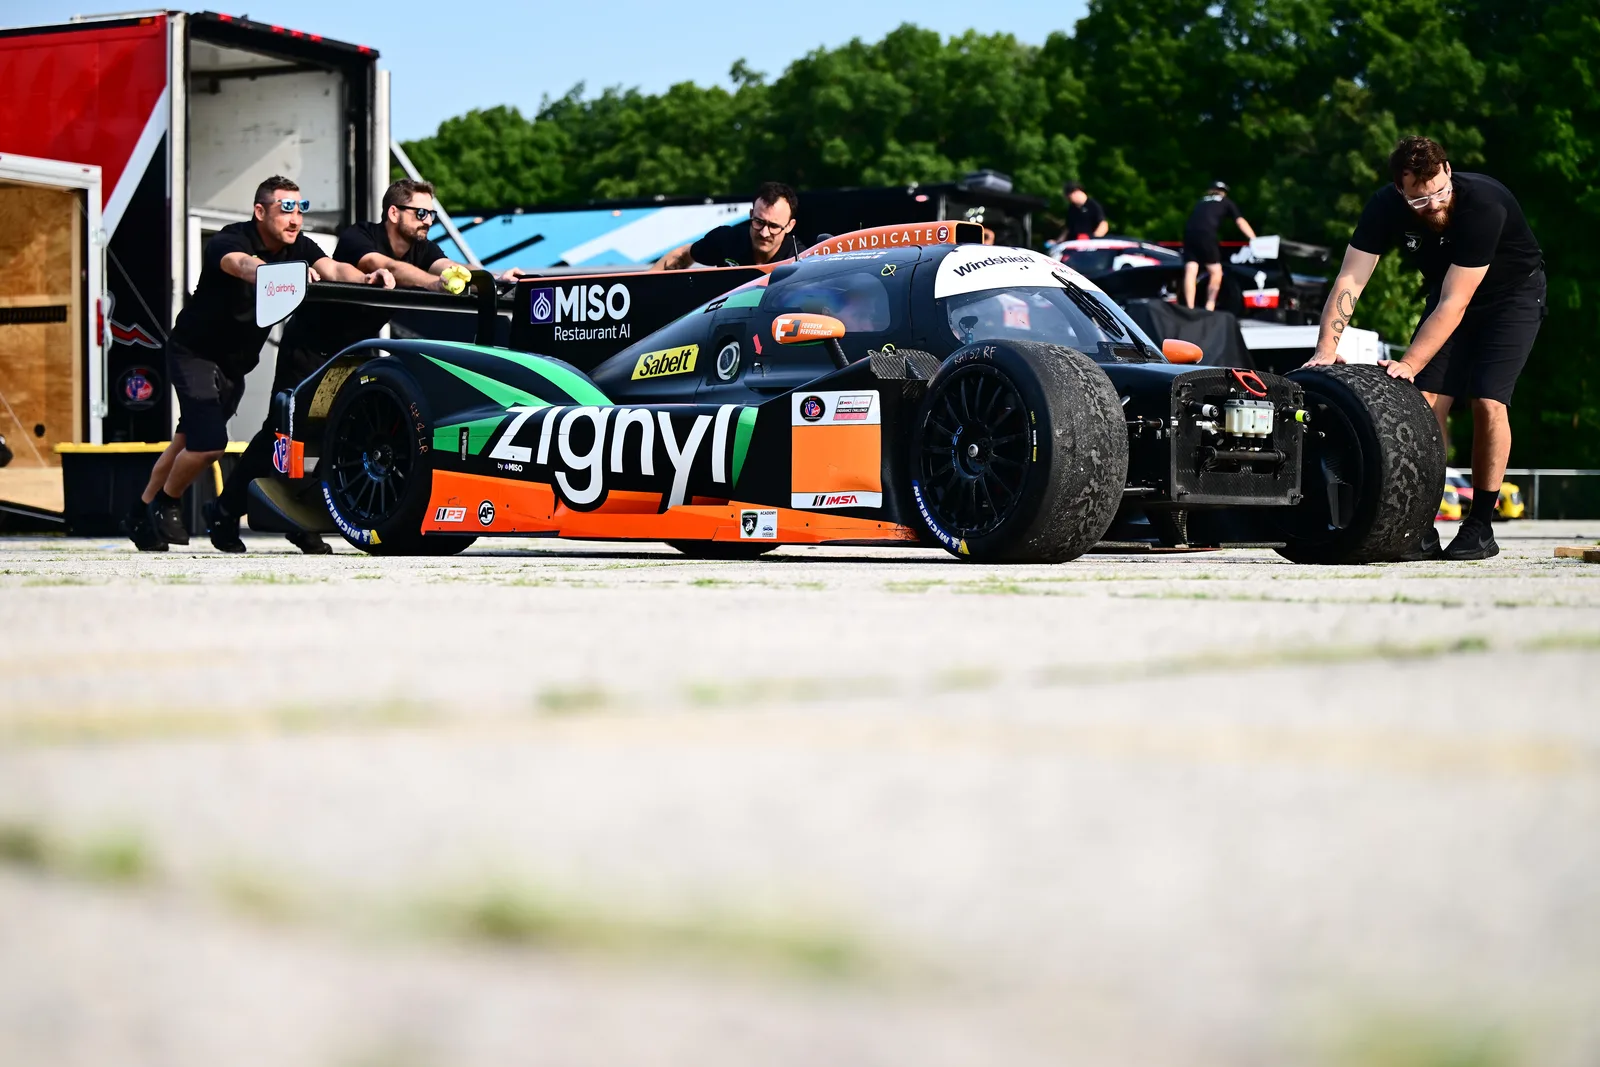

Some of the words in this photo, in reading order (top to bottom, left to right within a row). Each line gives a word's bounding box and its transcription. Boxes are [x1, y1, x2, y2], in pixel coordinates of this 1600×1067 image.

[836, 229, 933, 254] SYNDICATE
[953, 255, 1036, 277] Windshield
[555, 283, 631, 323] MISO
[554, 326, 617, 341] Restaurant
[619, 324, 631, 339] AI
[639, 348, 692, 377] Sabelt
[983, 345, 997, 360] RF
[488, 404, 740, 510] zignyl
[497, 463, 504, 471] by
[508, 463, 523, 472] MISO
[825, 495, 858, 505] IMSA
[322, 488, 361, 541] MICHELIN
[447, 510, 464, 519] P3
[913, 486, 950, 545] MICHELIN
